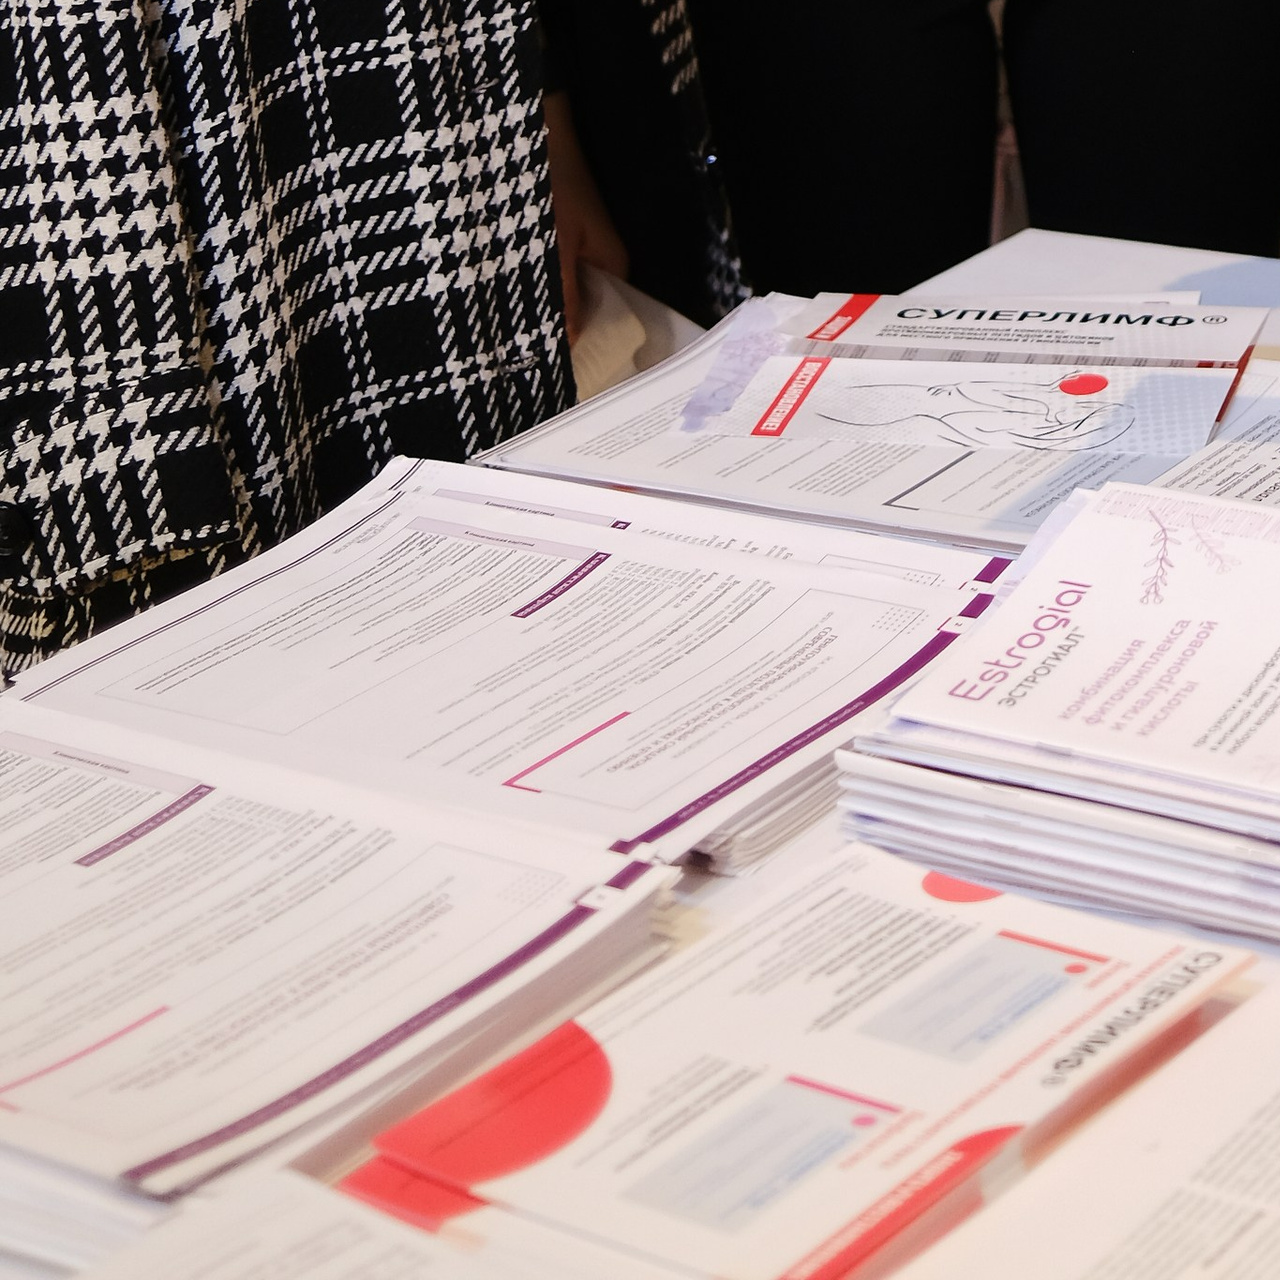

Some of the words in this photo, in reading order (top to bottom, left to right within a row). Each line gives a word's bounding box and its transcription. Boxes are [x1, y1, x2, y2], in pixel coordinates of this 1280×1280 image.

[948, 579, 1092, 701] Estrogial
[1060, 638, 1146, 720] комбинация
[1082, 618, 1192, 726] фитокомплекса
[1120, 620, 1219, 719] гиалуроновой
[1137, 680, 1199, 737] кислоты
